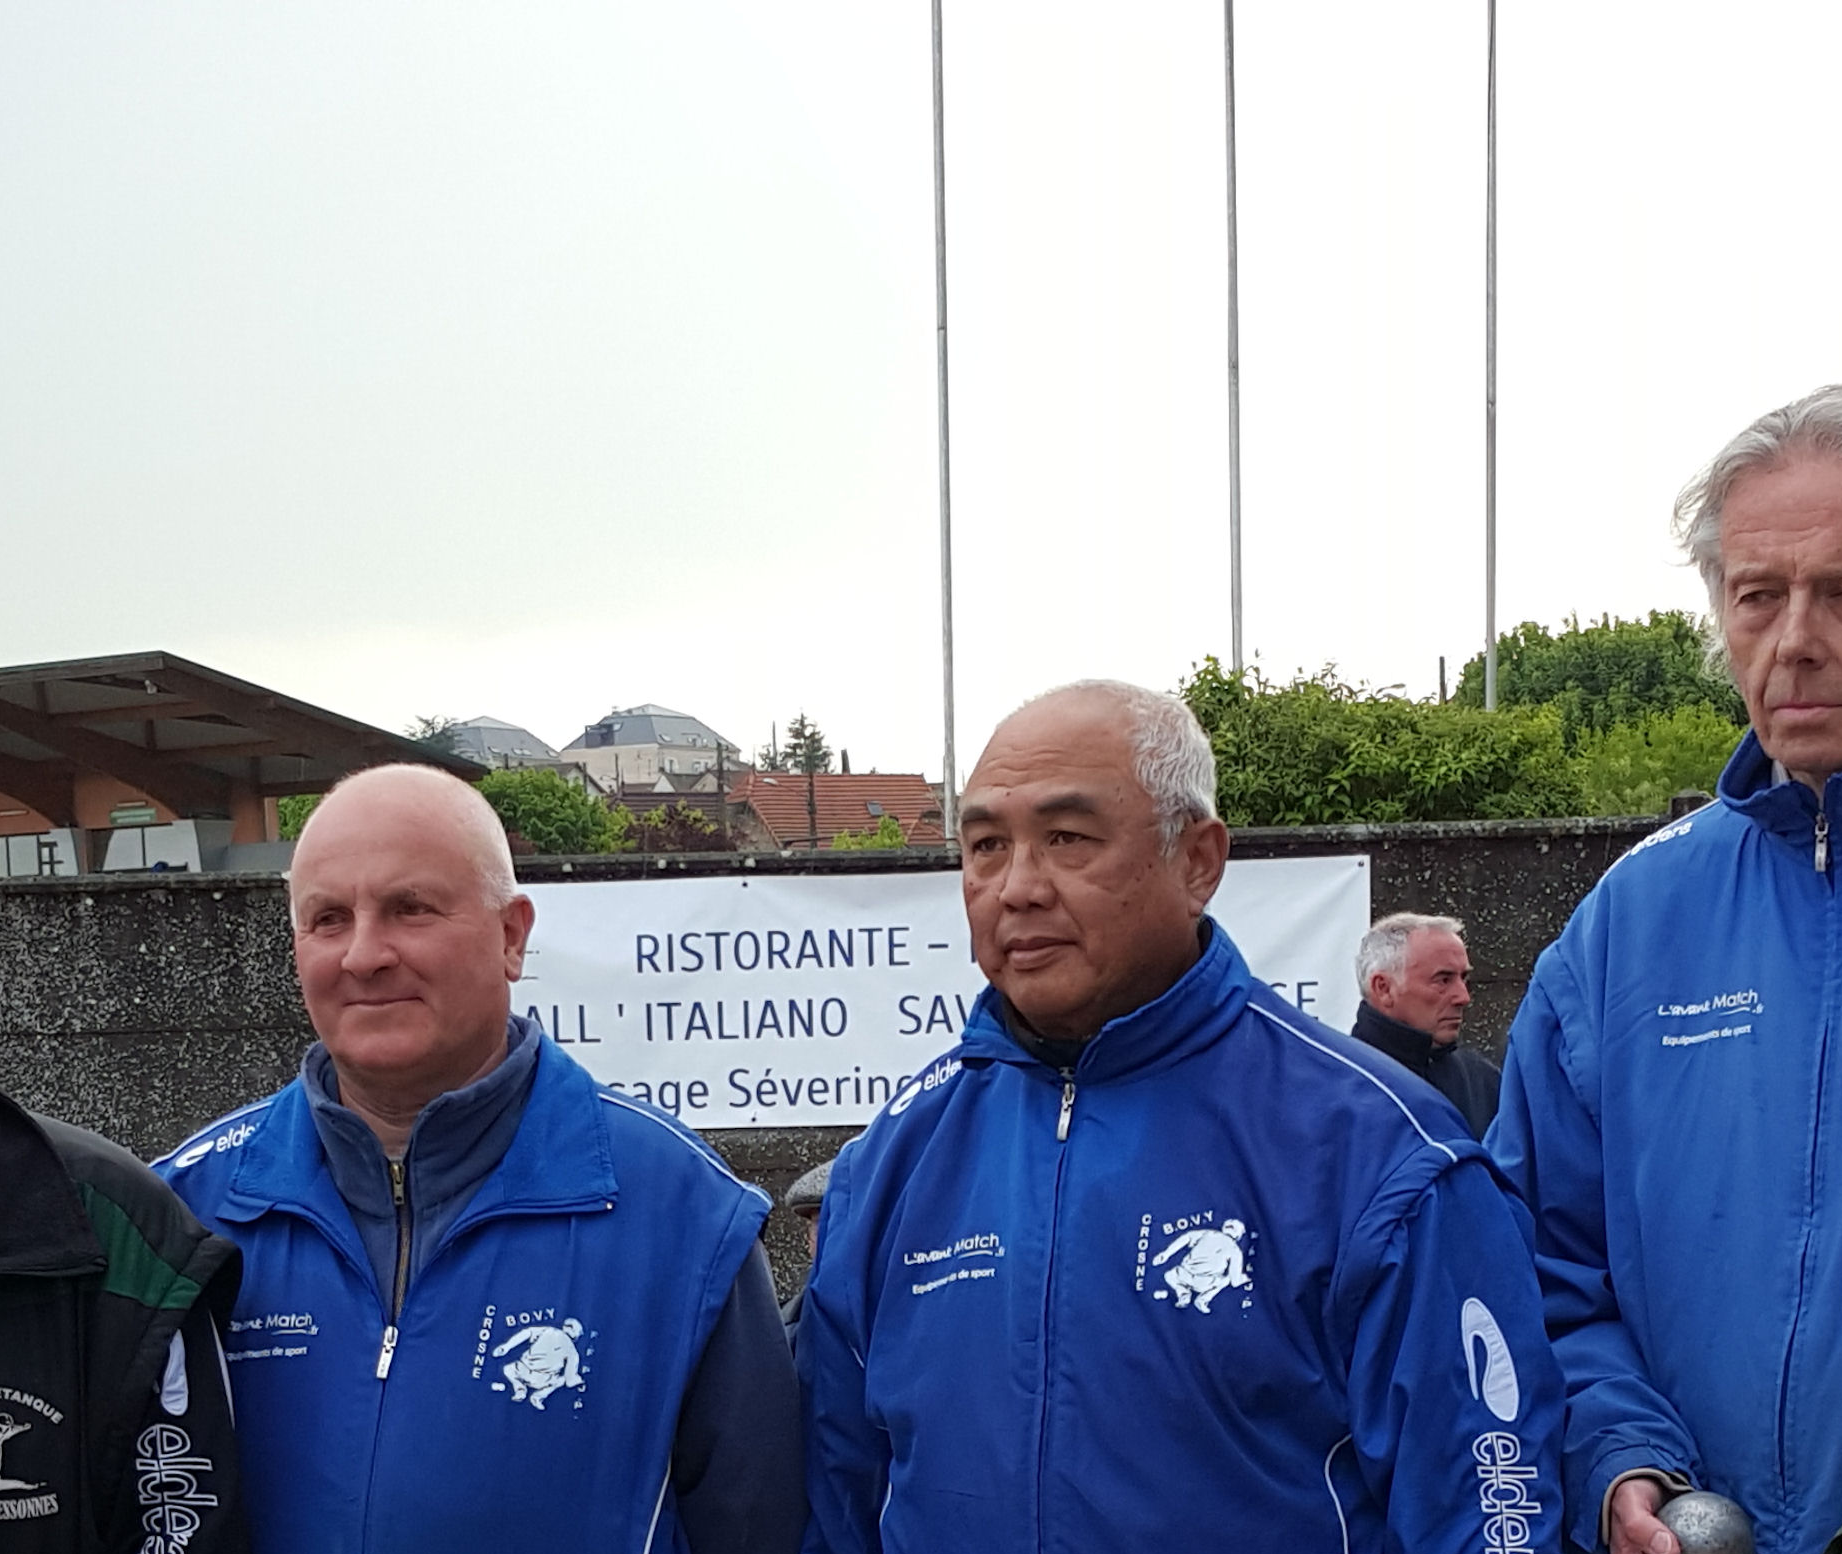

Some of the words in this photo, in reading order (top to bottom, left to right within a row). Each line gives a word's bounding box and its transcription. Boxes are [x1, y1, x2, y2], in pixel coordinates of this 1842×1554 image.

[635, 926, 911, 974] RISTORANTE
[645, 996, 849, 1042] ITALIANO
[899, 994, 981, 1036] SAV
[1712, 988, 1758, 1009] Match
[608, 1080, 709, 1118] age
[216, 1123, 260, 1152] elde
[1136, 1214, 1153, 1291] CROSNE
[265, 1312, 313, 1329] Match
[472, 1305, 496, 1379] CROSNE
